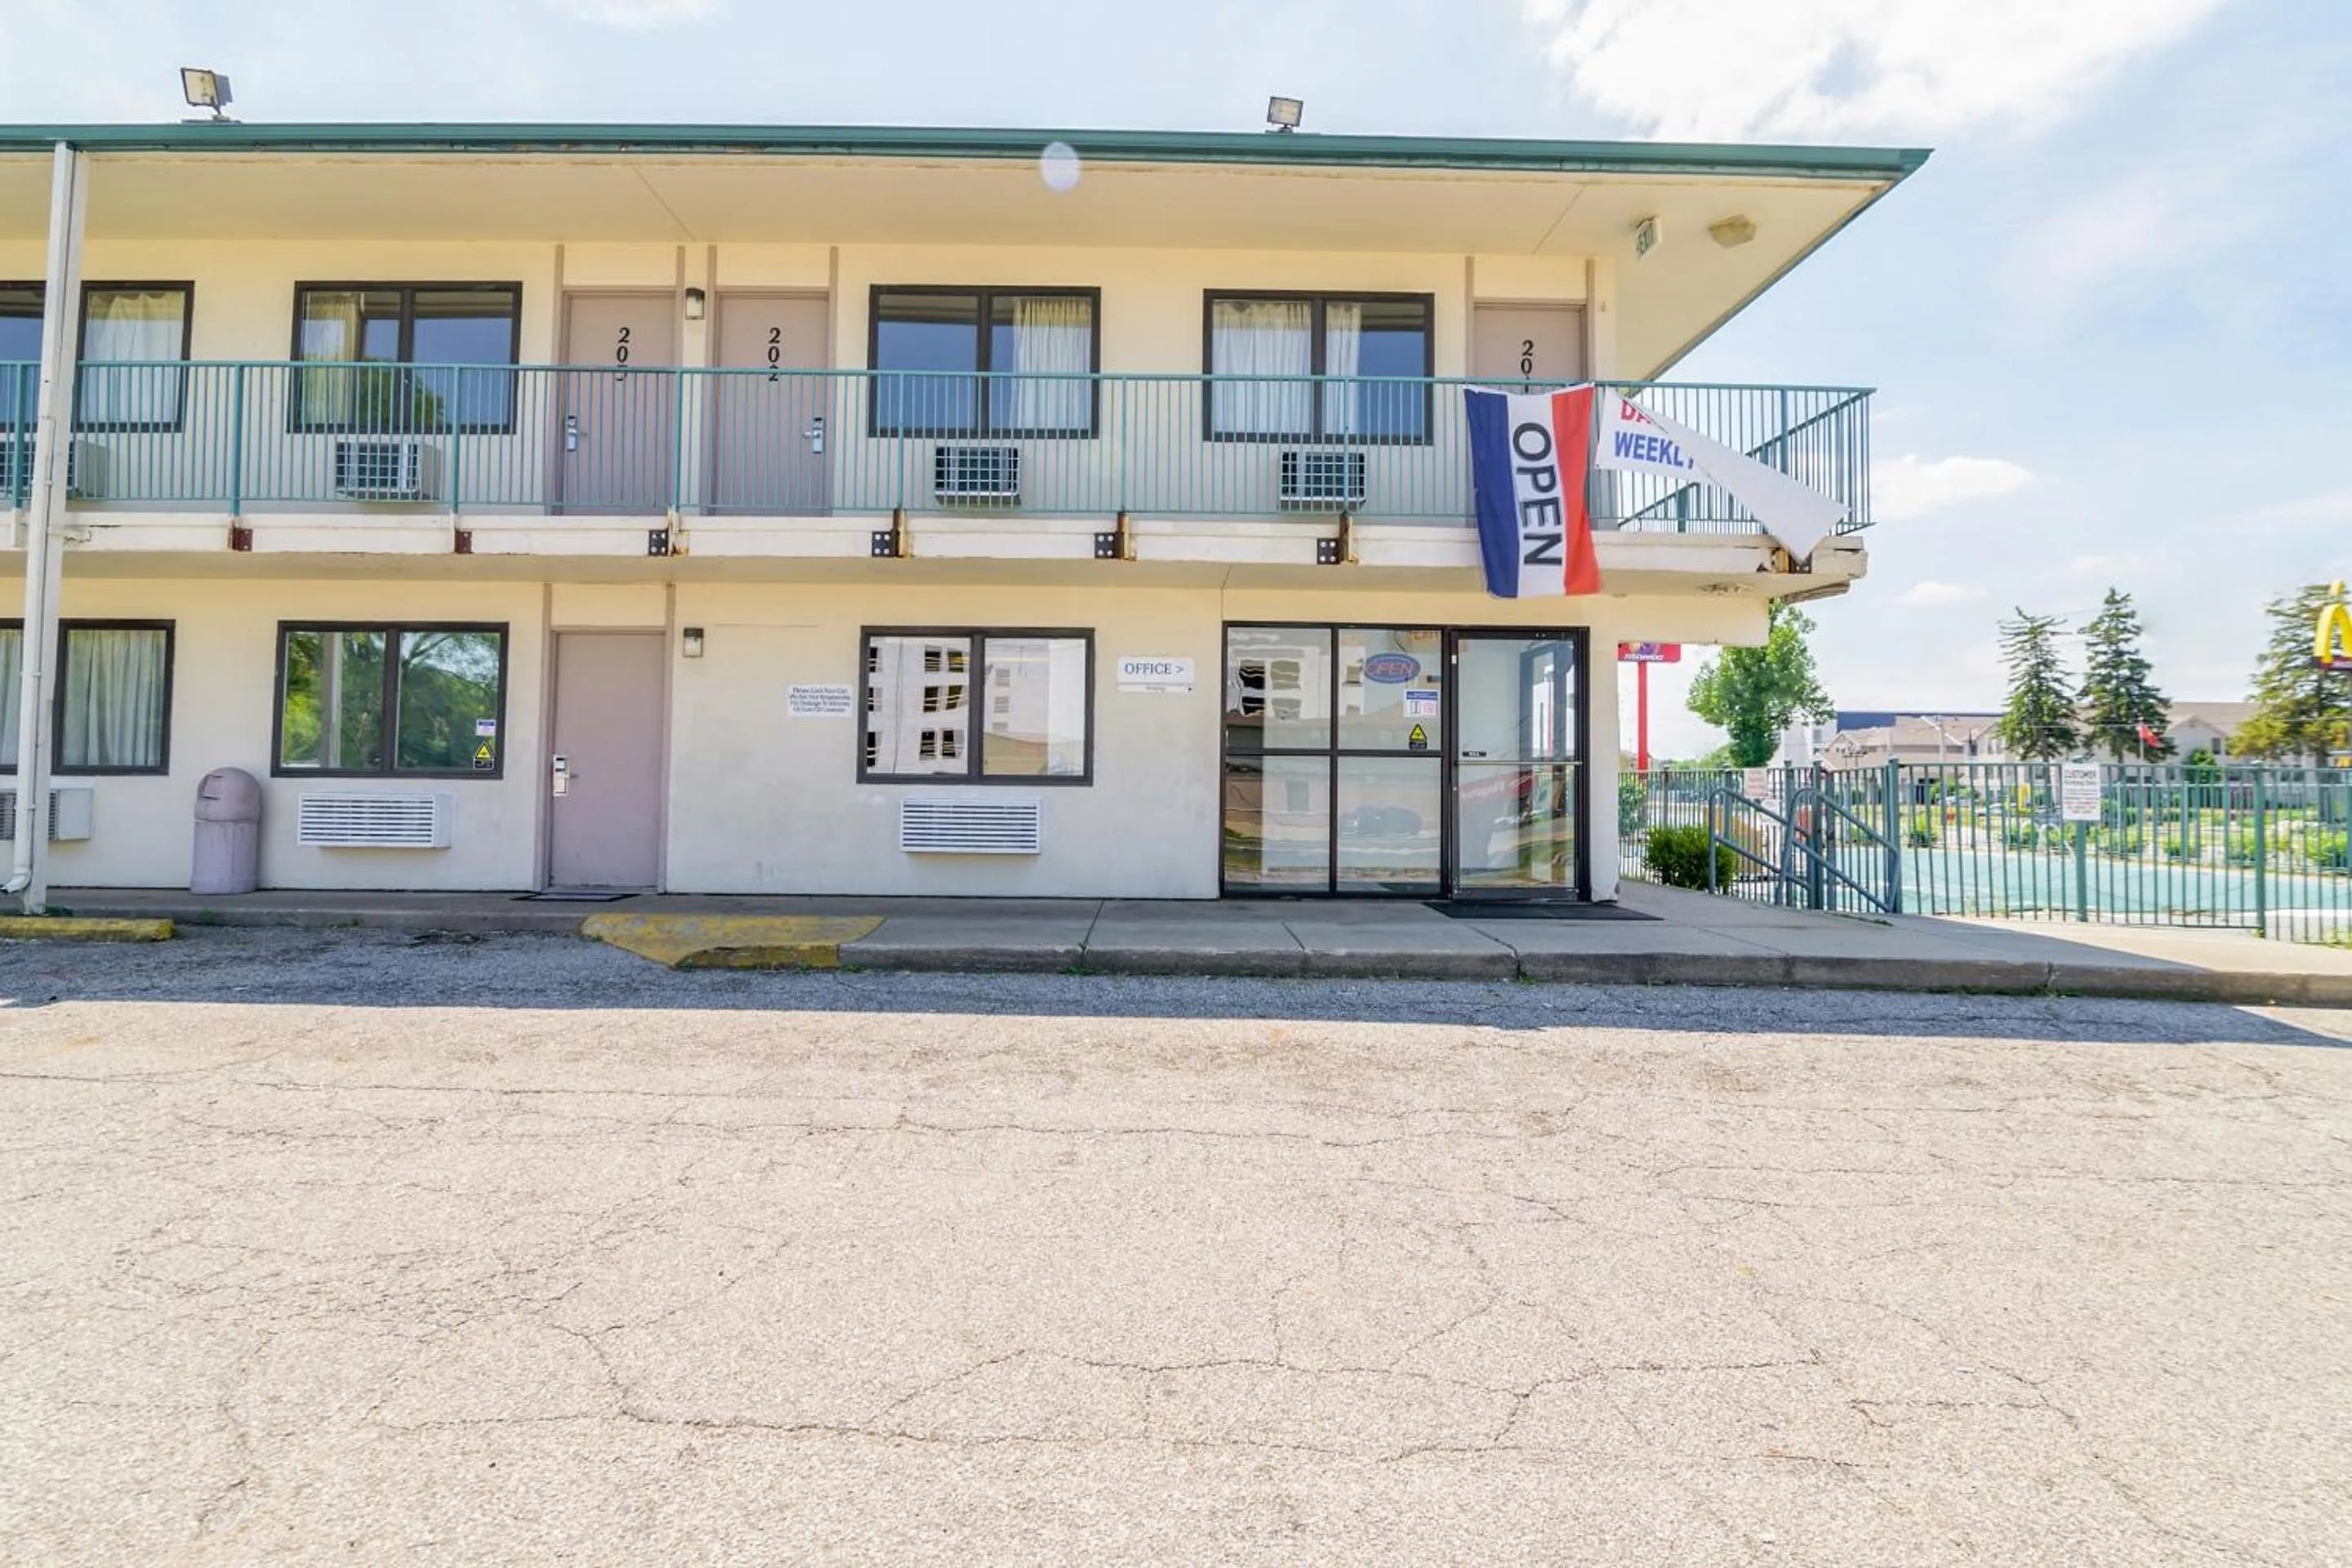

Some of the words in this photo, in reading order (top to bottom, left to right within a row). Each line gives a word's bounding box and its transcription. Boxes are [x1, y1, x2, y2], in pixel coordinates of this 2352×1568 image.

[1512, 421, 1563, 566] OPEN
[1125, 662, 1172, 675] OFFICE
[1365, 662, 1414, 676] OPEN
